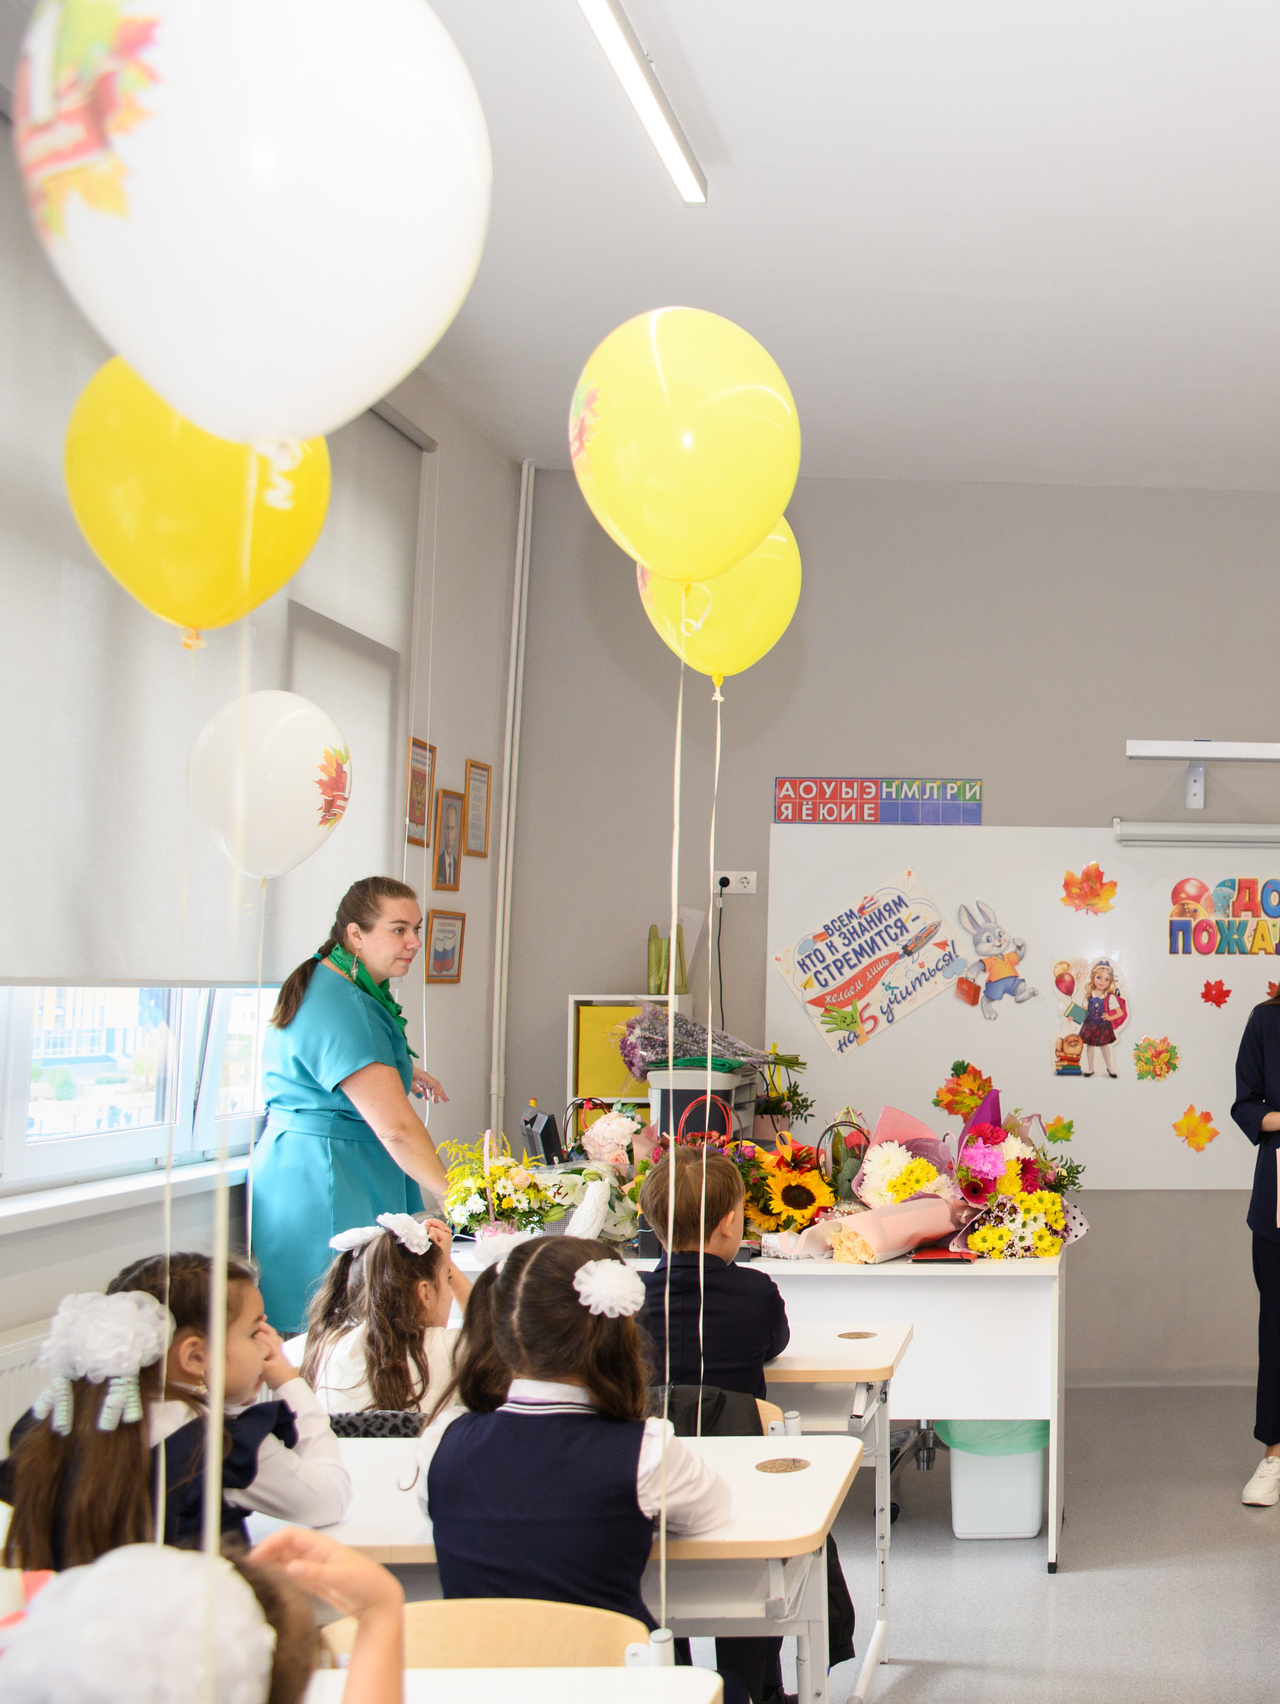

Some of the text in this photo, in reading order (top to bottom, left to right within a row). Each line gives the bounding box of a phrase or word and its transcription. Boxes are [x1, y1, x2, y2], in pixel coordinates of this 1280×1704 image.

[797, 894, 909, 975] КТО К ЗНАНИЯМ
[813, 917, 910, 988] СТРЕМИТСЯ
[824, 957, 890, 1004] желаем лишь
[837, 939, 960, 1053] на 5 учиться!
